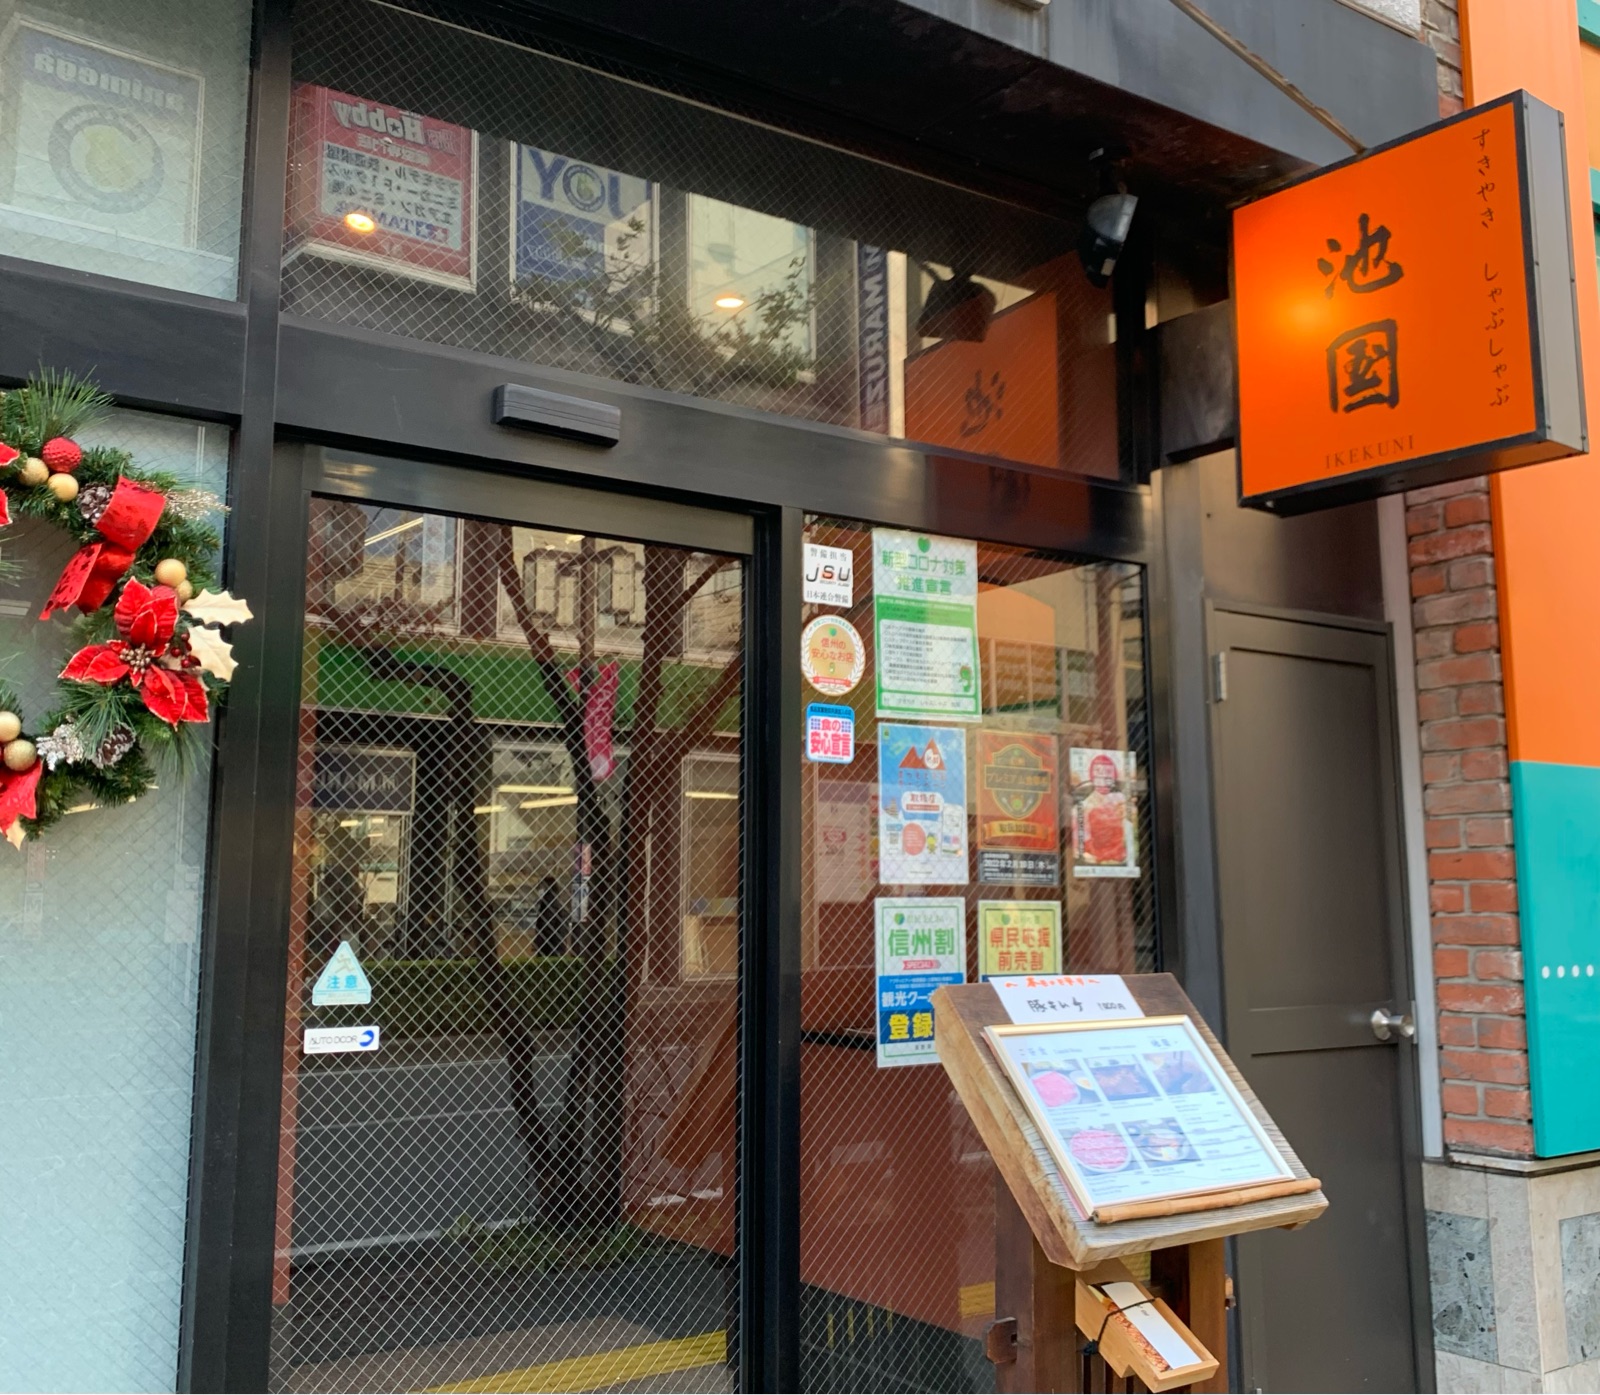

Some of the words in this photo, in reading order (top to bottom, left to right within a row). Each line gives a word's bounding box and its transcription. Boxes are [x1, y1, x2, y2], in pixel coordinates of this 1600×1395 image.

[1472, 129, 1496, 229] すきやき
[1484, 263, 1510, 407] しゃぶしゃぶ
[1317, 213, 1404, 414] 池国
[1325, 435, 1416, 470] IKEKUNI
[810, 547, 848, 562] 警備担当
[882, 549, 967, 577] 新型コロナ対策
[811, 647, 854, 663] 安心なお店
[821, 637, 846, 650] 信州の
[821, 718, 841, 732] 食の
[810, 731, 851, 757] 安心宣言
[888, 928, 955, 957] 信州割
[990, 927, 1051, 948] 県民応援
[998, 950, 1044, 972] 前売割
[888, 1012, 934, 1040] 登録
[308, 1036, 332, 1046] AUTO
[333, 1034, 358, 1045] DOOR
